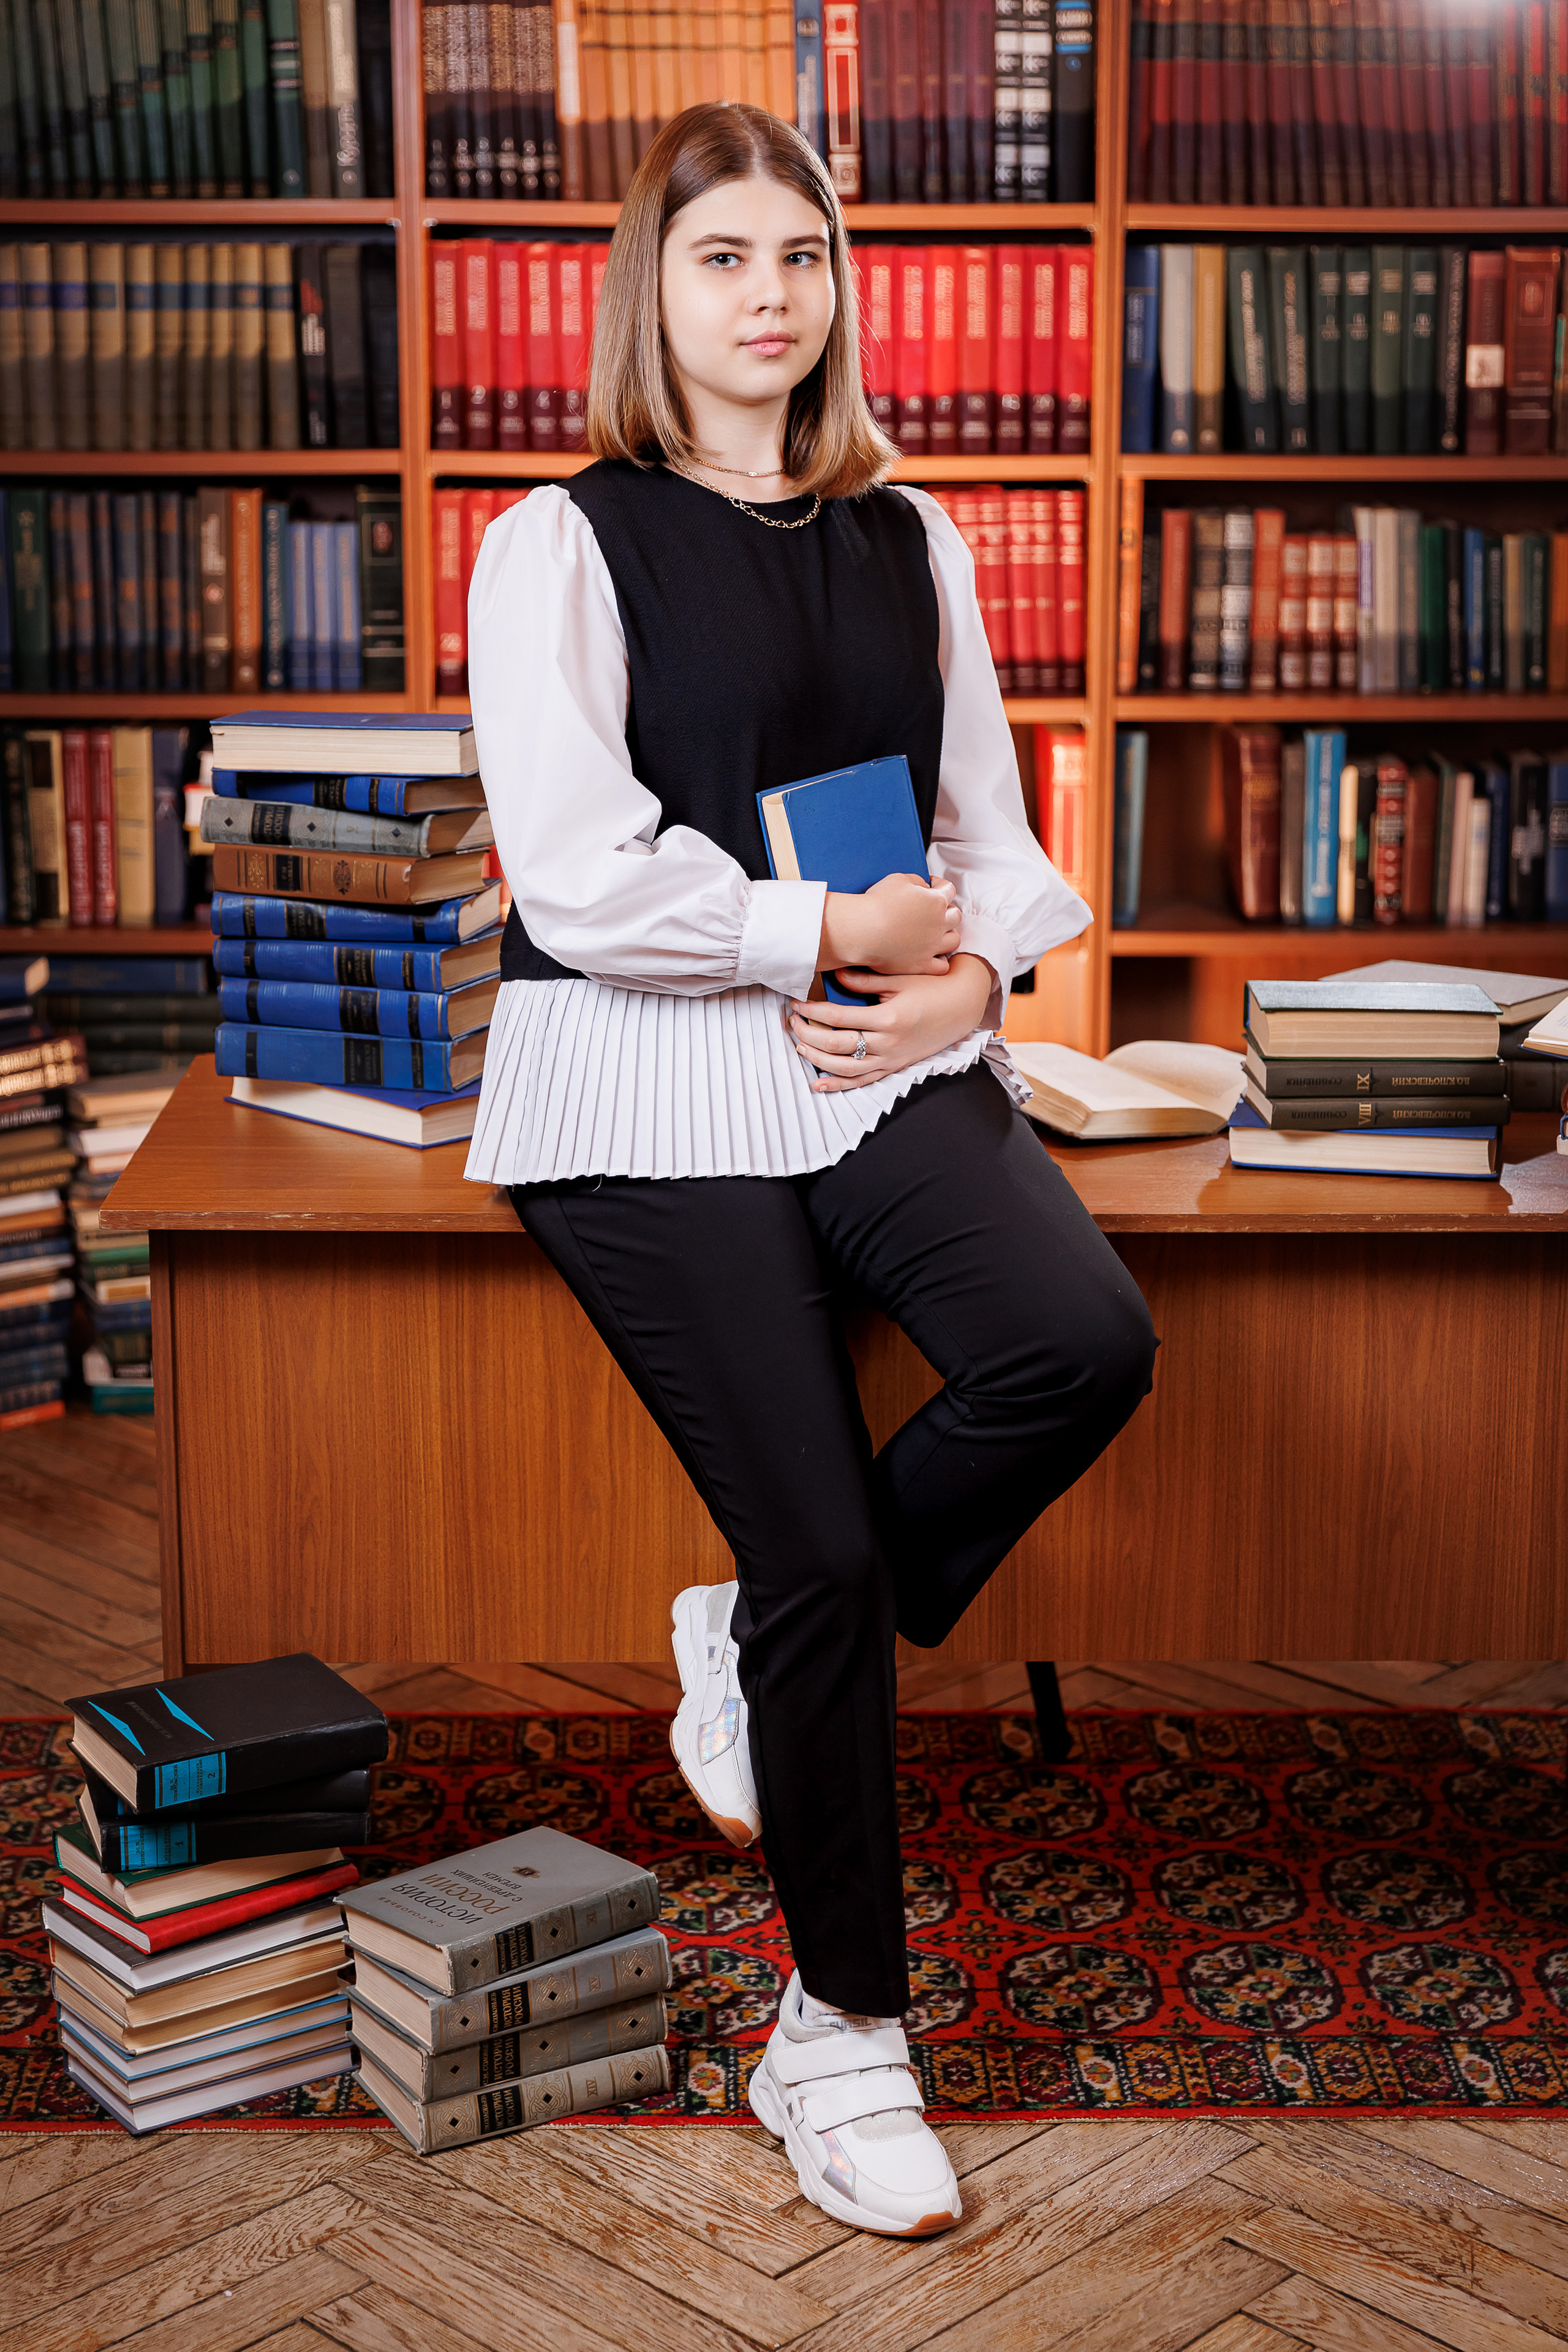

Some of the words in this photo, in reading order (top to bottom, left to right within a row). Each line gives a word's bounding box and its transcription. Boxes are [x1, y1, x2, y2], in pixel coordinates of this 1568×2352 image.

[1286, 1077, 1343, 1086] СОЧИНЕНИЯ
[1357, 1073, 1370, 1091] IX
[1291, 1110, 1348, 1119] СОЧИНЕНИЯ
[1358, 1102, 1372, 1126] VIII
[418, 1873, 511, 1915] РОССИИ
[450, 1869, 516, 1898] ДРЕВНЕЙШИХ
[482, 1871, 522, 1890] ВРЕМЕН
[391, 1883, 483, 1924] ИСТОРИЯ
[508, 1929, 519, 1969] ИСТОРИЯ
[517, 1926, 529, 1964] РОССИИ
[502, 1988, 513, 2029] ИСТОРИЯ
[512, 1986, 523, 2026] РОССИИ
[586, 2076, 598, 2098] XIV
[492, 2091, 504, 2130] ИСТОРИЯ
[503, 2089, 515, 2128] РОССИИ
